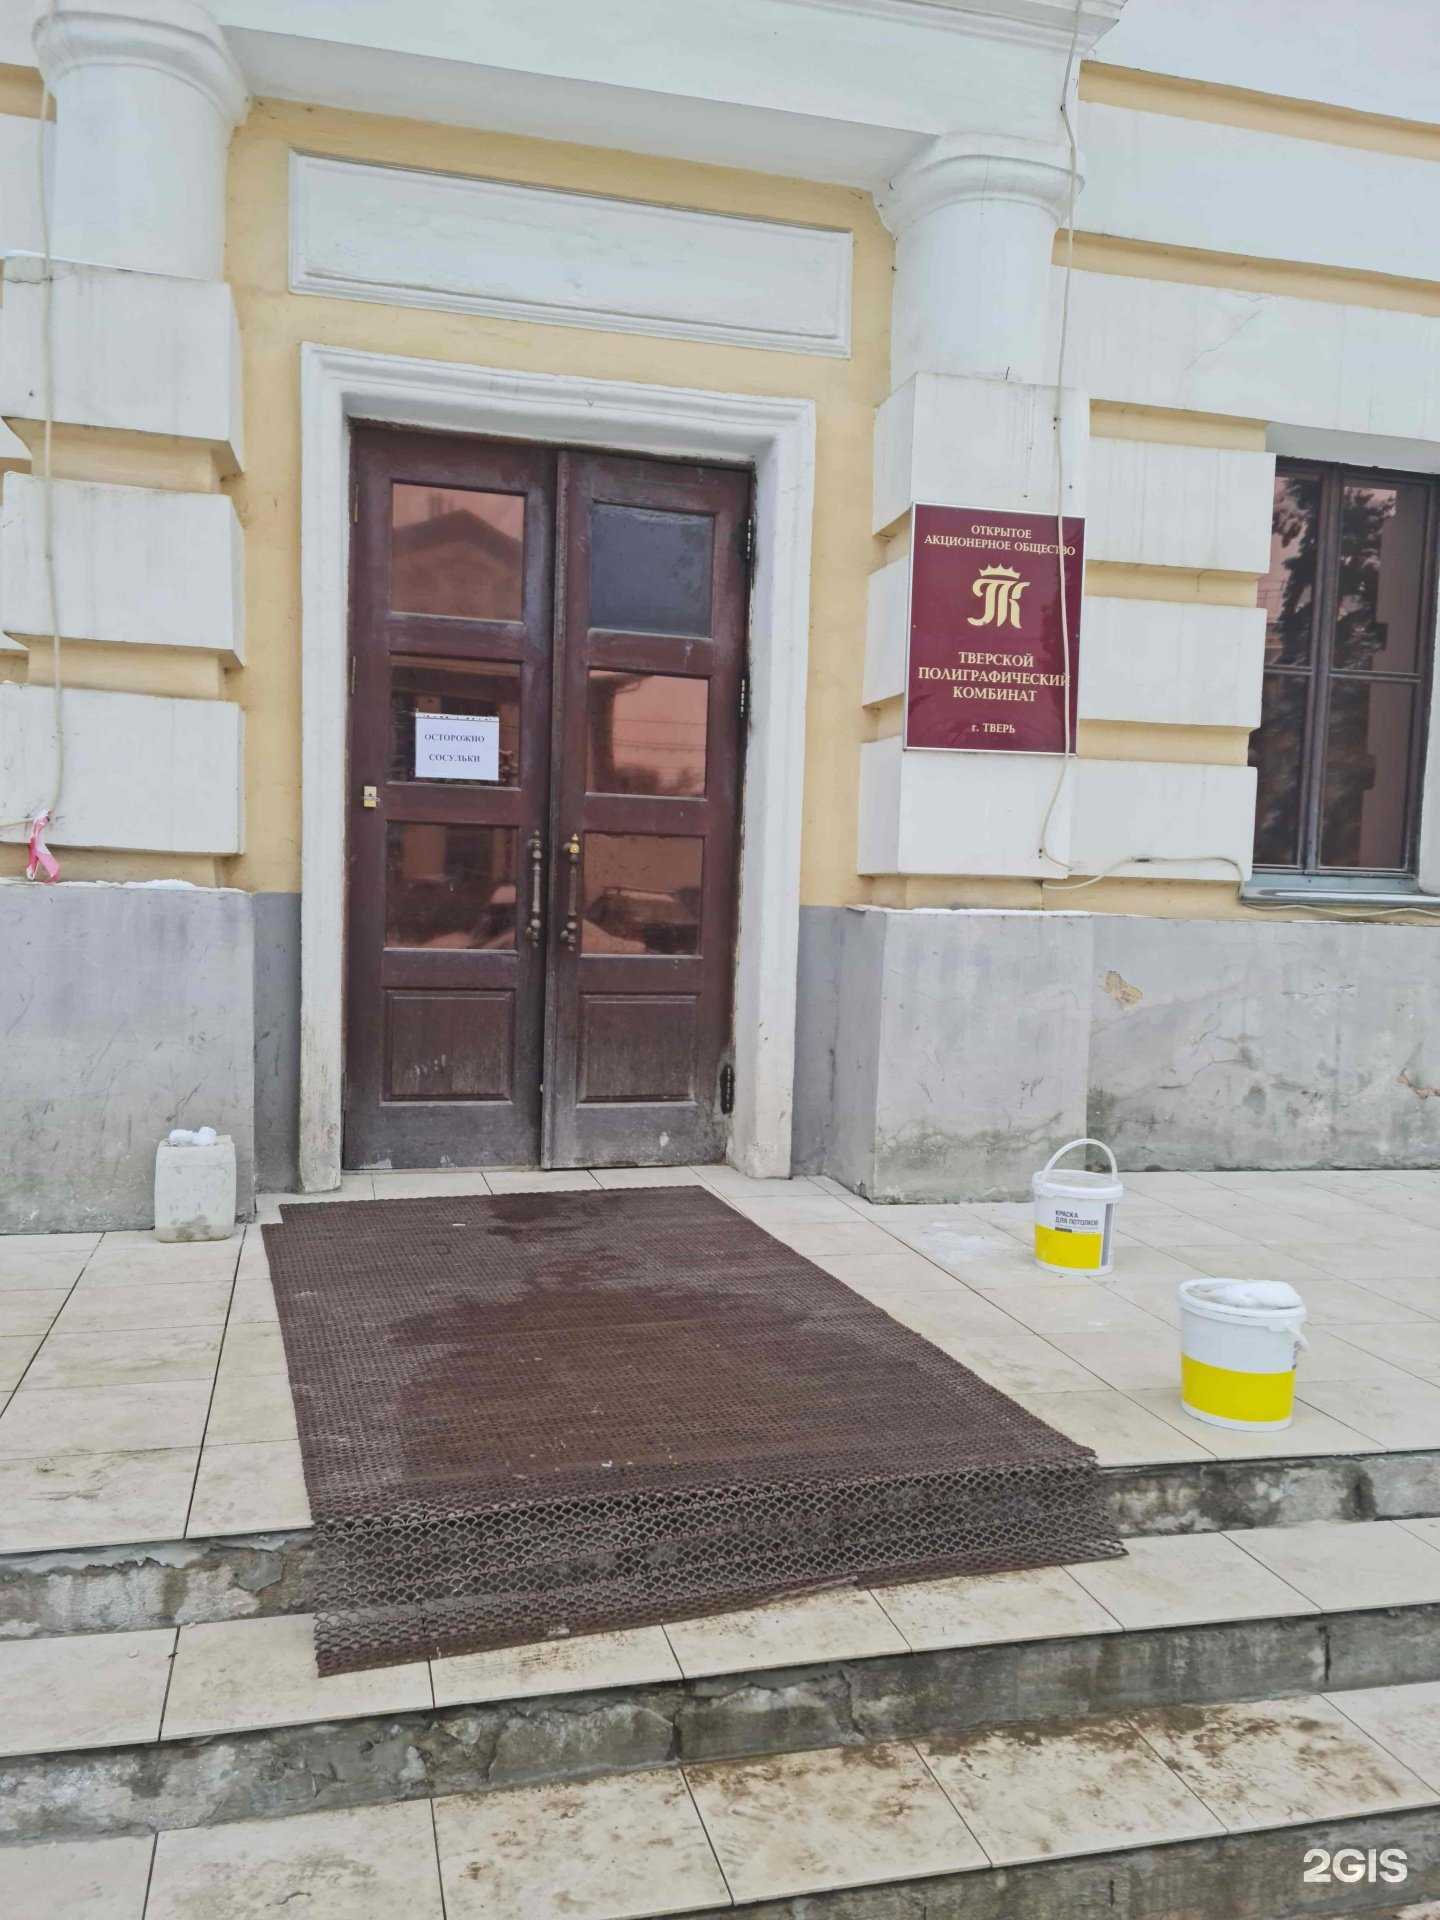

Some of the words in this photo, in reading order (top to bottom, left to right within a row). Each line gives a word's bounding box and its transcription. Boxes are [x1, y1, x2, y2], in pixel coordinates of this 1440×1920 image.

[971, 524, 1033, 539] ОТКРЫТОЕ
[924, 534, 1012, 551] АКЦИОНЕРНОЕ
[958, 651, 1035, 668] ТВЕРСКОЙ
[953, 686, 1038, 702] КОМБИНАТ
[982, 722, 1016, 734] ТВЕРЬ
[424, 733, 485, 742] ОСТОРОЖНО
[428, 753, 480, 763] СОСУЛЬКИ
